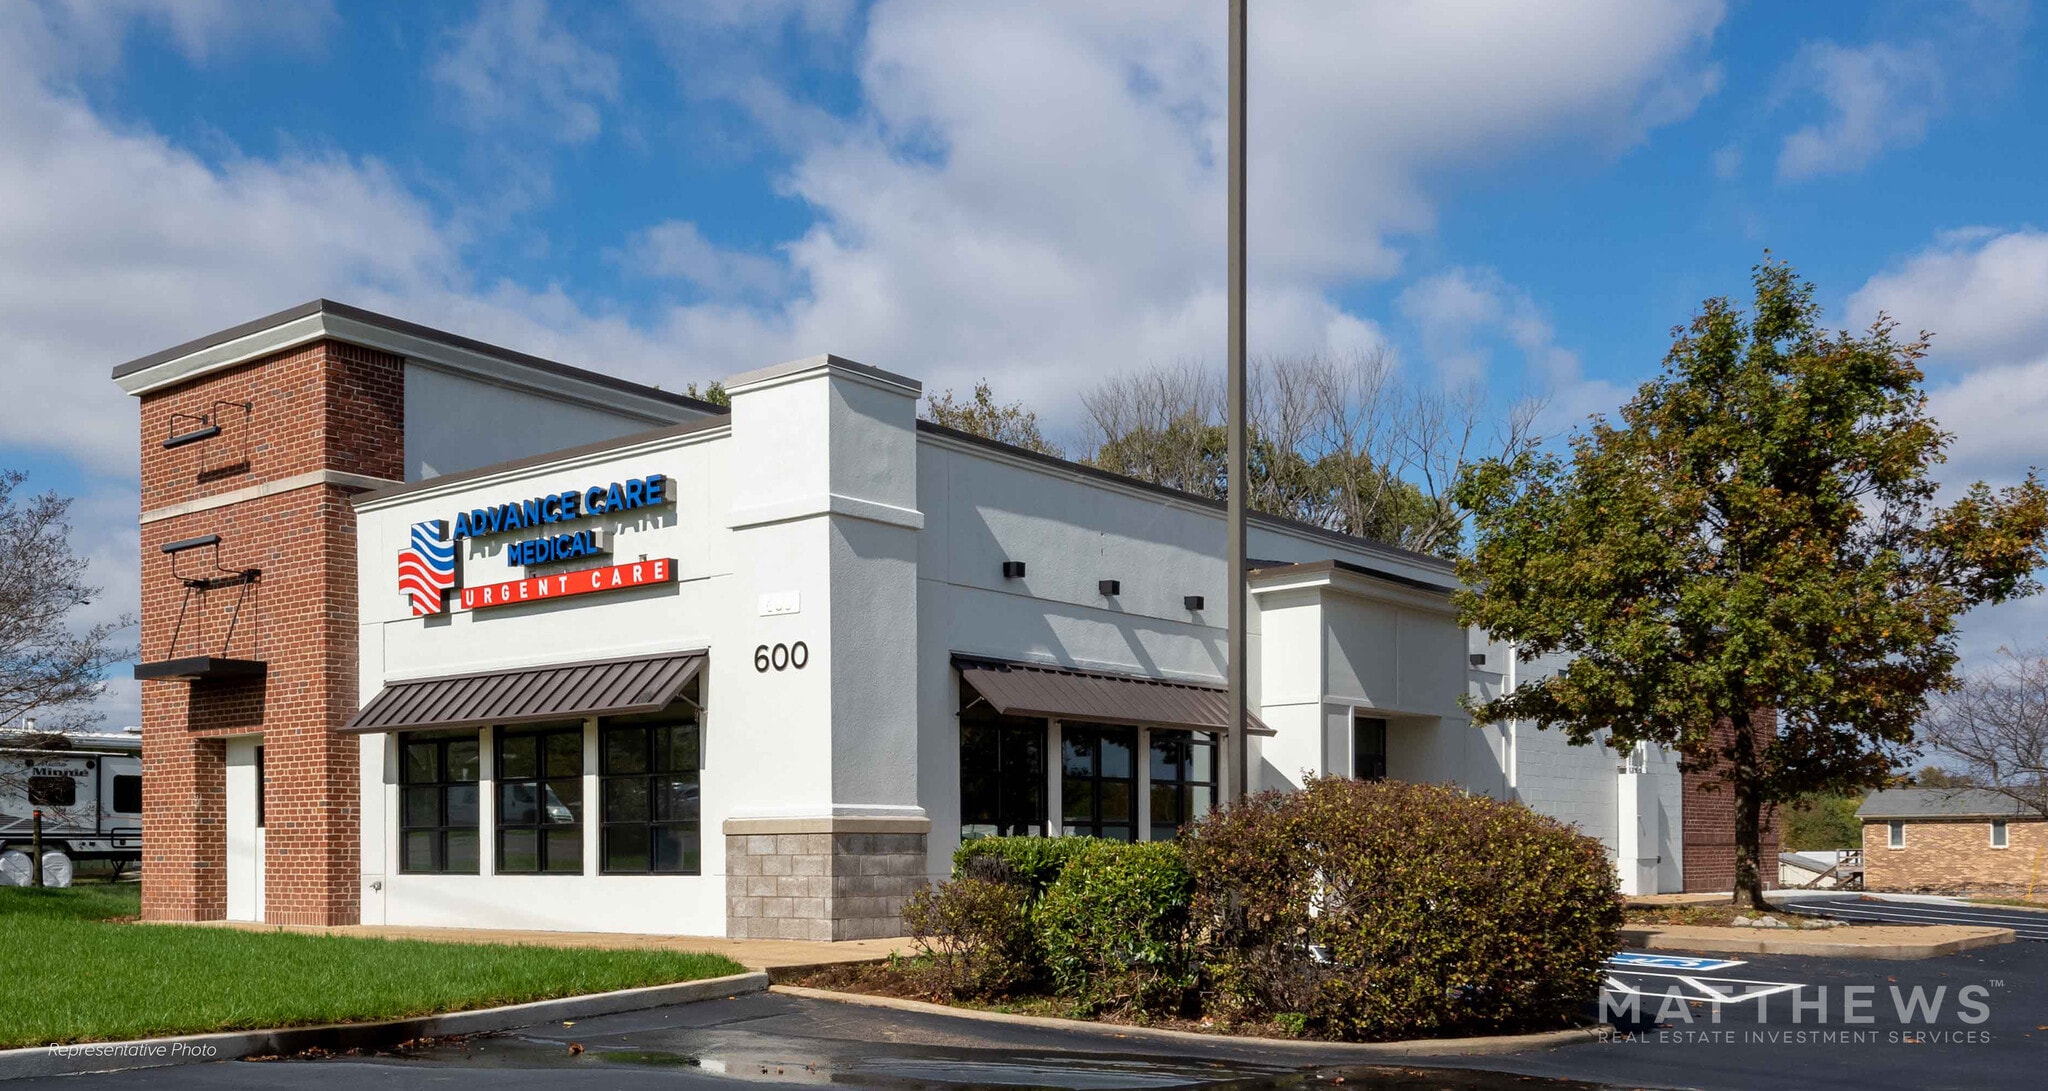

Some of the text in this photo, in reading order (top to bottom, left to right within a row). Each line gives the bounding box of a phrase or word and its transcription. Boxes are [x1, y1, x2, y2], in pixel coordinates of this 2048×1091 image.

[453, 474, 665, 540] ADVANCE CARE
[507, 530, 599, 567] MEDICAL
[465, 561, 664, 606] URGENT CARE
[754, 640, 809, 673] 600
[33, 767, 89, 777] Minnie
